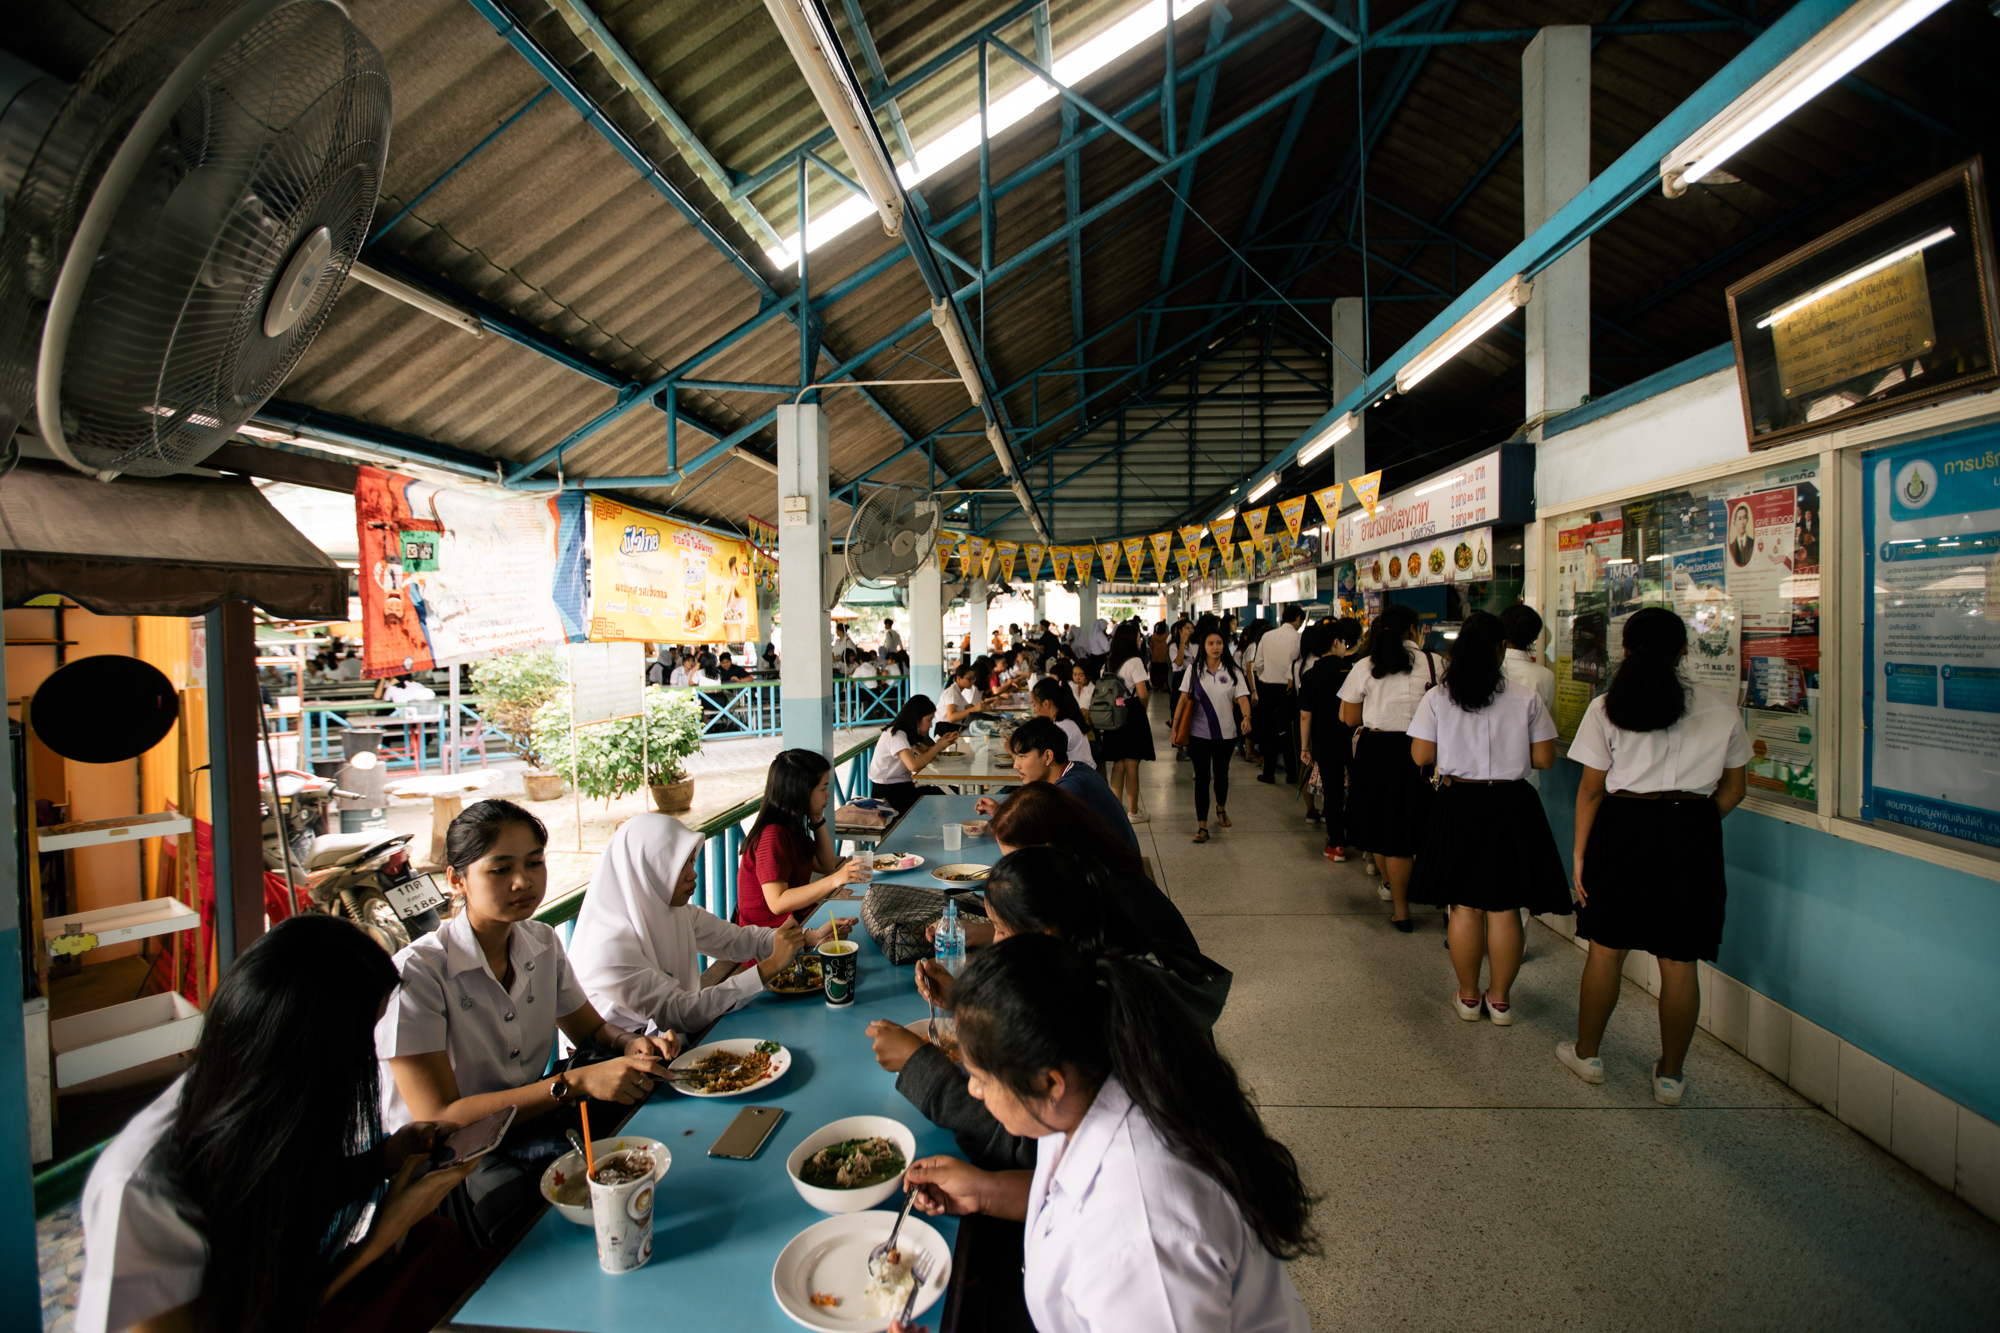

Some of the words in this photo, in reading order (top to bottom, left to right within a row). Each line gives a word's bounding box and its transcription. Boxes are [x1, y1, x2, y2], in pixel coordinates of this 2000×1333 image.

[1475, 465, 1486, 481] บาท
[1451, 495, 1455, 509] 2
[1455, 488, 1467, 508] อย่าง
[1475, 486, 1486, 501] บาท
[1451, 514, 1455, 528] 3
[1455, 508, 1467, 527] อย่าง
[1475, 506, 1486, 522] บาท
[1755, 518, 1769, 528] GIVE
[1771, 515, 1793, 525] BLOOD
[622, 524, 661, 555] ฟ้าไทย
[1755, 528, 1769, 537] GIVE
[1771, 527, 1782, 536] LIFE
[1324, 530, 1330, 557] 4
[1883, 546, 1889, 559] 1
[1609, 565, 1639, 579] iMAP
[1903, 817, 1918, 826] 074
[1919, 820, 1977, 841] 28210-1/074
[403, 896, 437, 916] 5186
